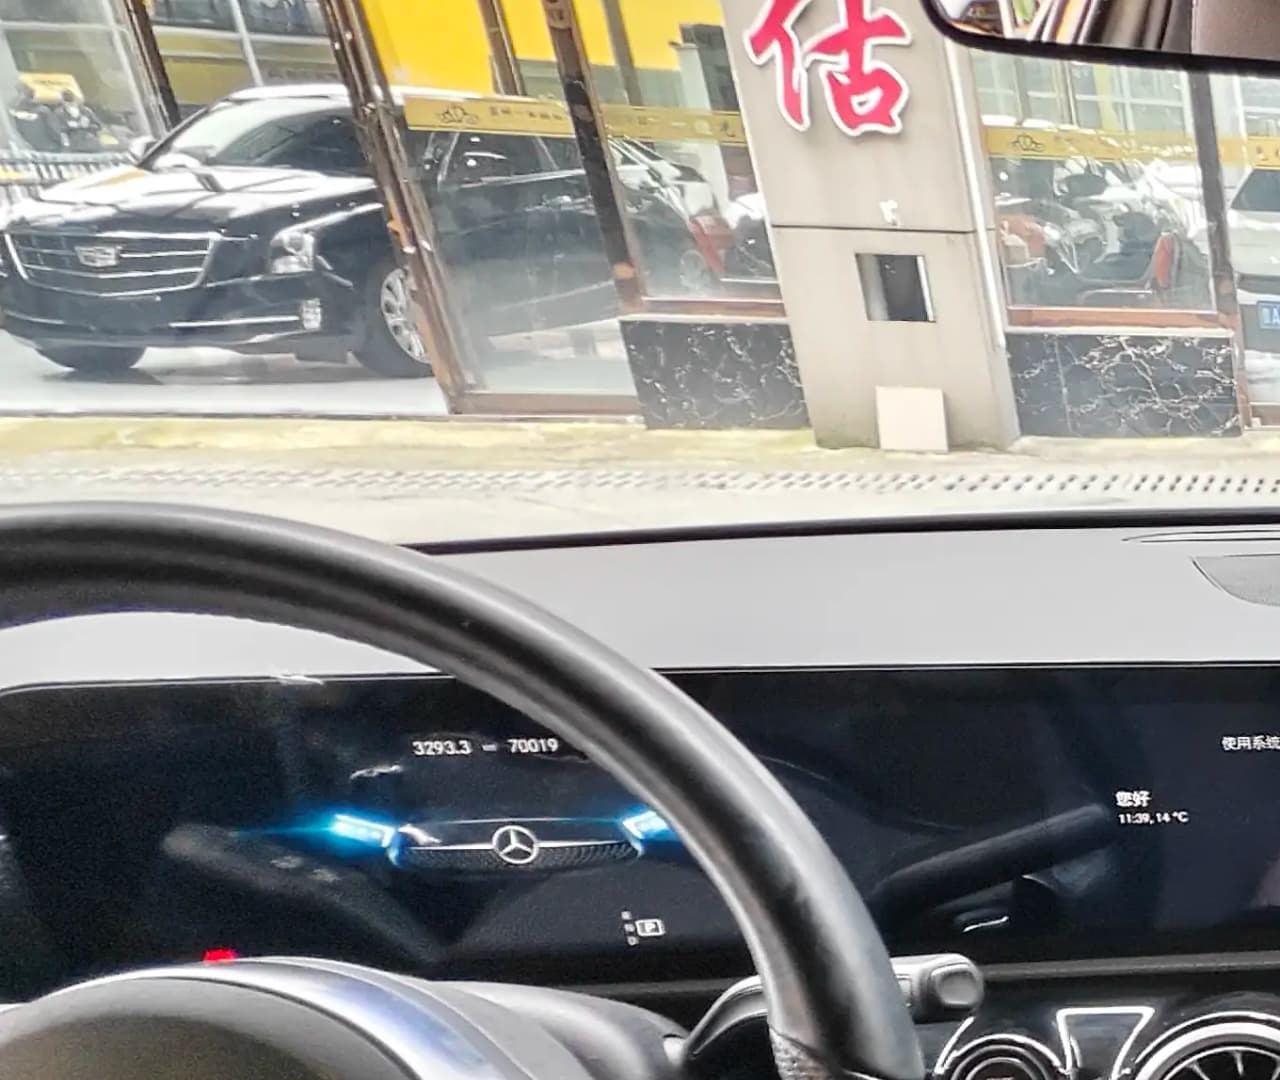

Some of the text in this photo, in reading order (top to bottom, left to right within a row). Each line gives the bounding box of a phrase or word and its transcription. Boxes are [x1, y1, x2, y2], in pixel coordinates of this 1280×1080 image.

[743, 0, 911, 135] 估
[411, 739, 473, 756] 3293.3
[507, 737, 559, 754] 70019
[1115, 789, 1153, 808] 您好
